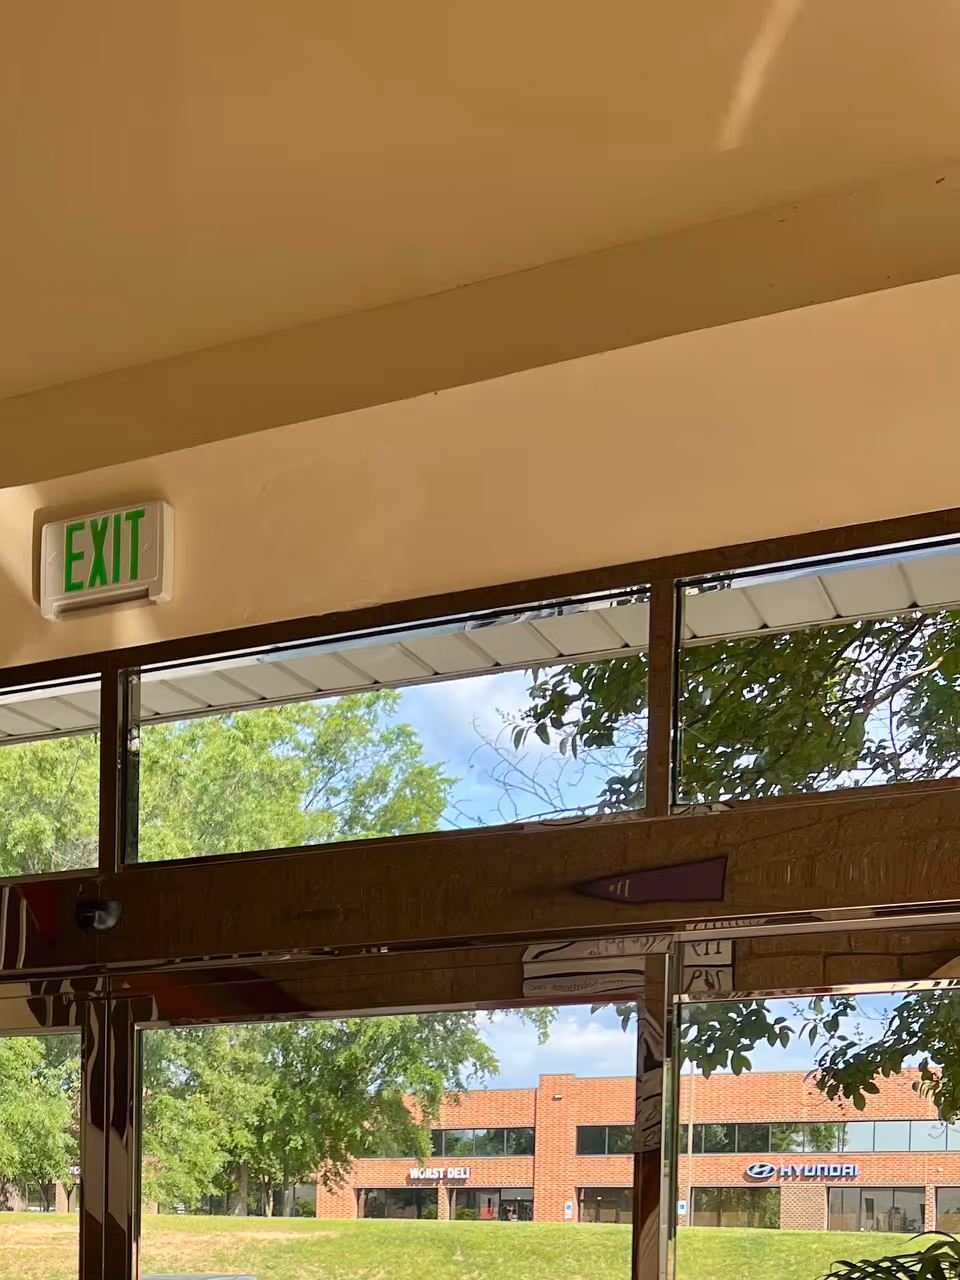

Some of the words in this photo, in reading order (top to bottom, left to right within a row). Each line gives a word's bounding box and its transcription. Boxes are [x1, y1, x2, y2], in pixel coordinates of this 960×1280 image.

[64, 508, 146, 593] EXIT
[409, 1167, 444, 1179] WORST
[446, 1167, 470, 1179] DELI
[780, 1163, 859, 1177] HYUNDAI
